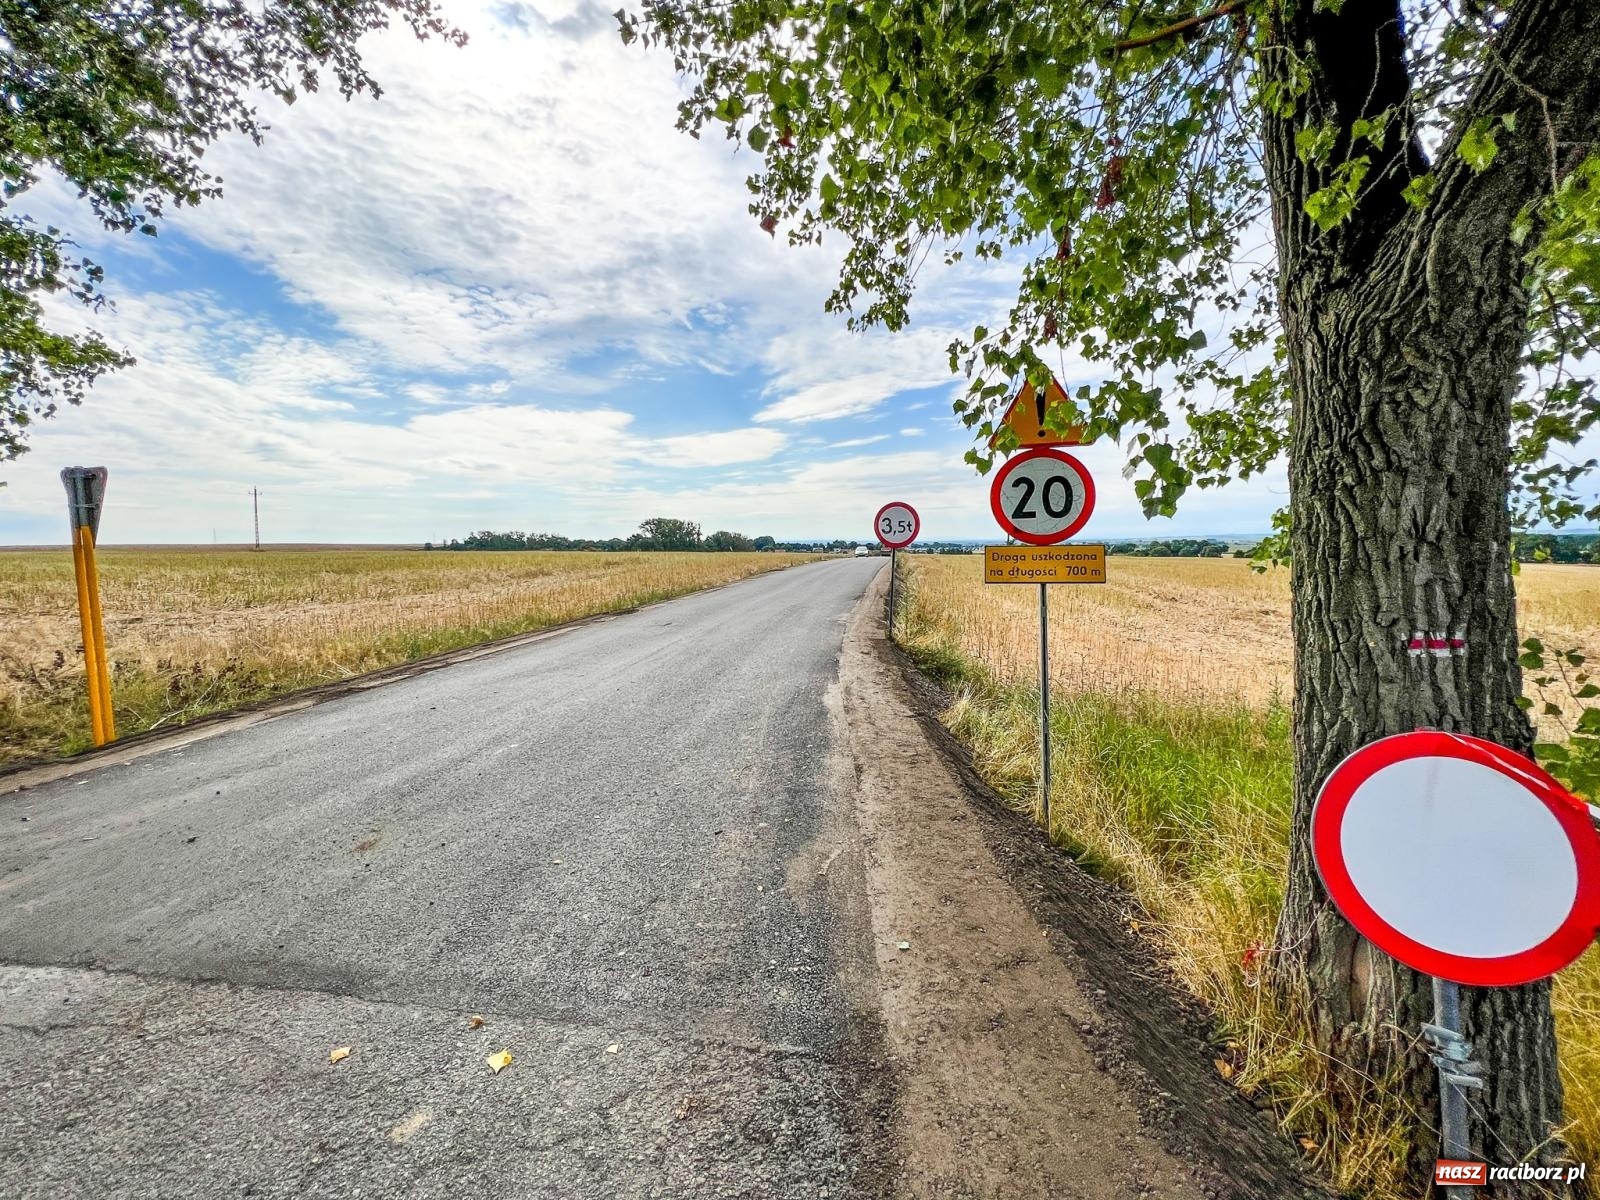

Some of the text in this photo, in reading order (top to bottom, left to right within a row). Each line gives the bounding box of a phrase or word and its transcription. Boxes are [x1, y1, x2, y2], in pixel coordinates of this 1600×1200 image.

[1011, 475, 1073, 519] 20
[881, 517, 912, 536] 3,5t
[992, 552, 1097, 563] Droga uszkodzona
[1066, 566, 1087, 576] 700
